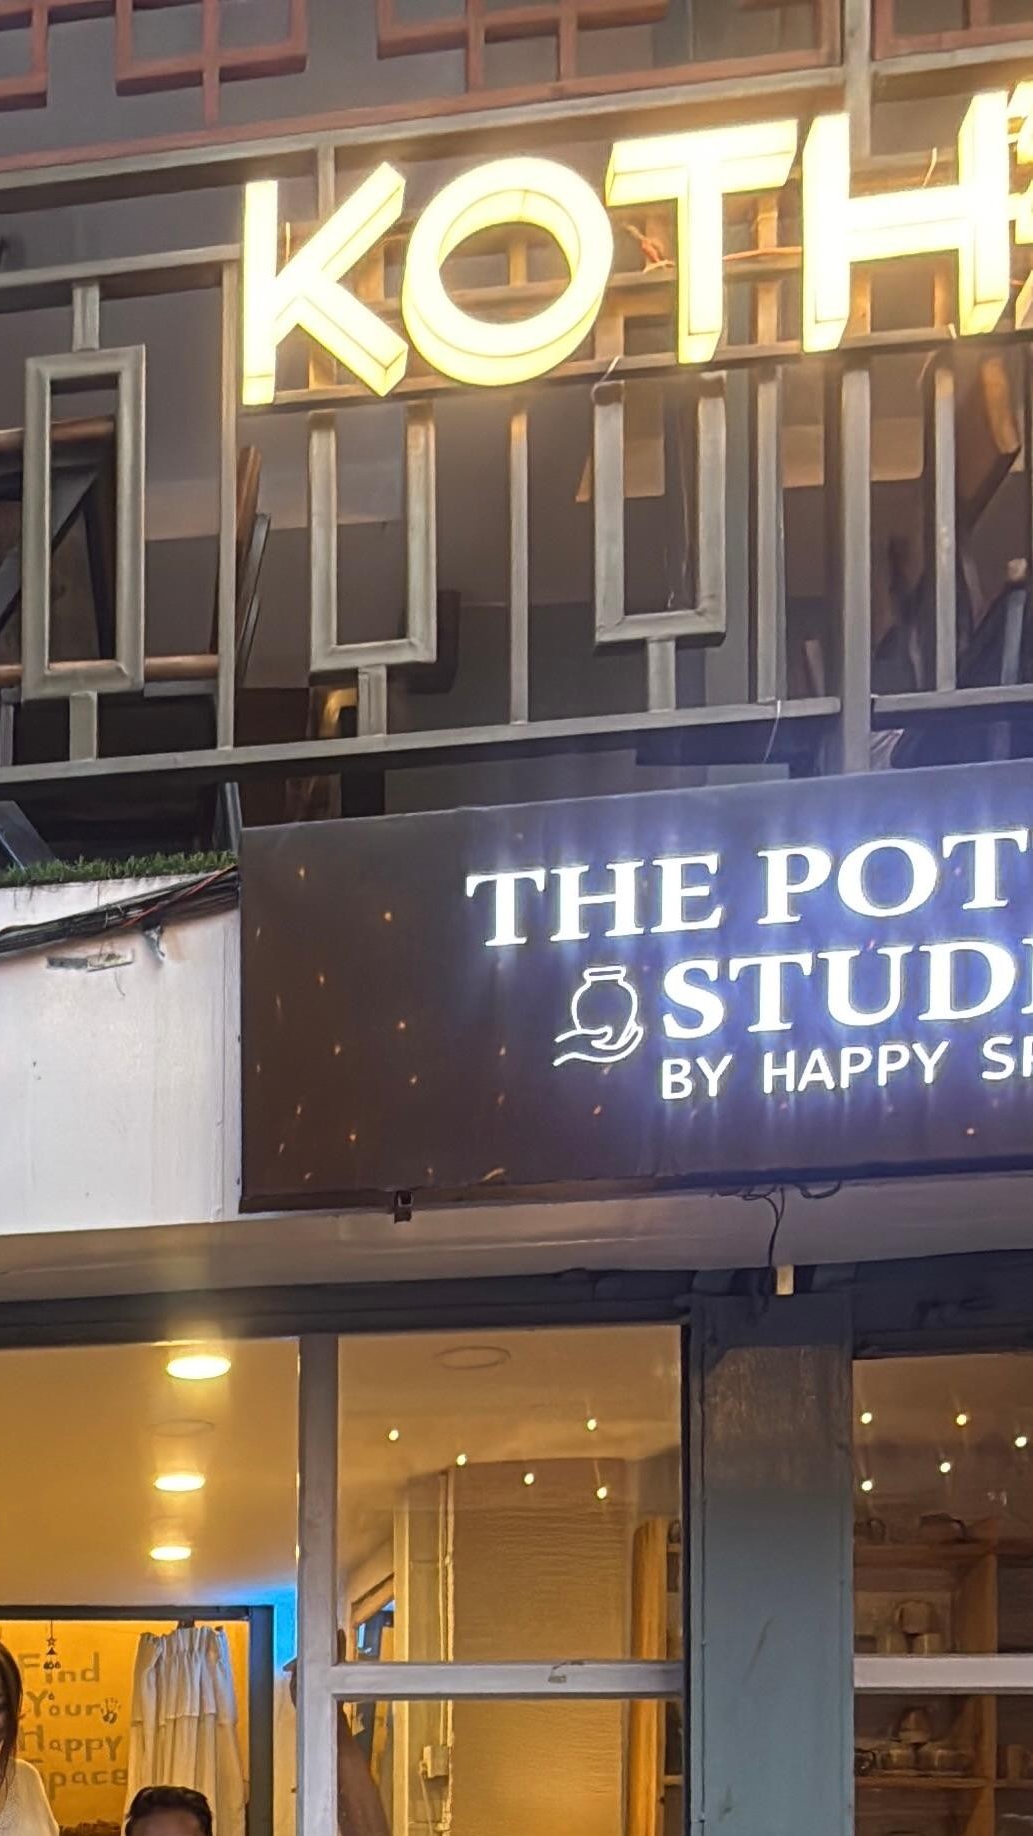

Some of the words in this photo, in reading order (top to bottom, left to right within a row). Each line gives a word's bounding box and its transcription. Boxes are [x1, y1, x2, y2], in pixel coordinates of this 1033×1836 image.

[465, 852, 726, 947] THE
[756, 828, 1029, 925] POT
[661, 937, 1033, 1040] STUD
[661, 1055, 733, 1101] BY
[763, 1040, 951, 1094] HAPPY
[17, 1651, 100, 1684] Find
[26, 1689, 101, 1718] Your
[25, 1757, 129, 1801] pace
